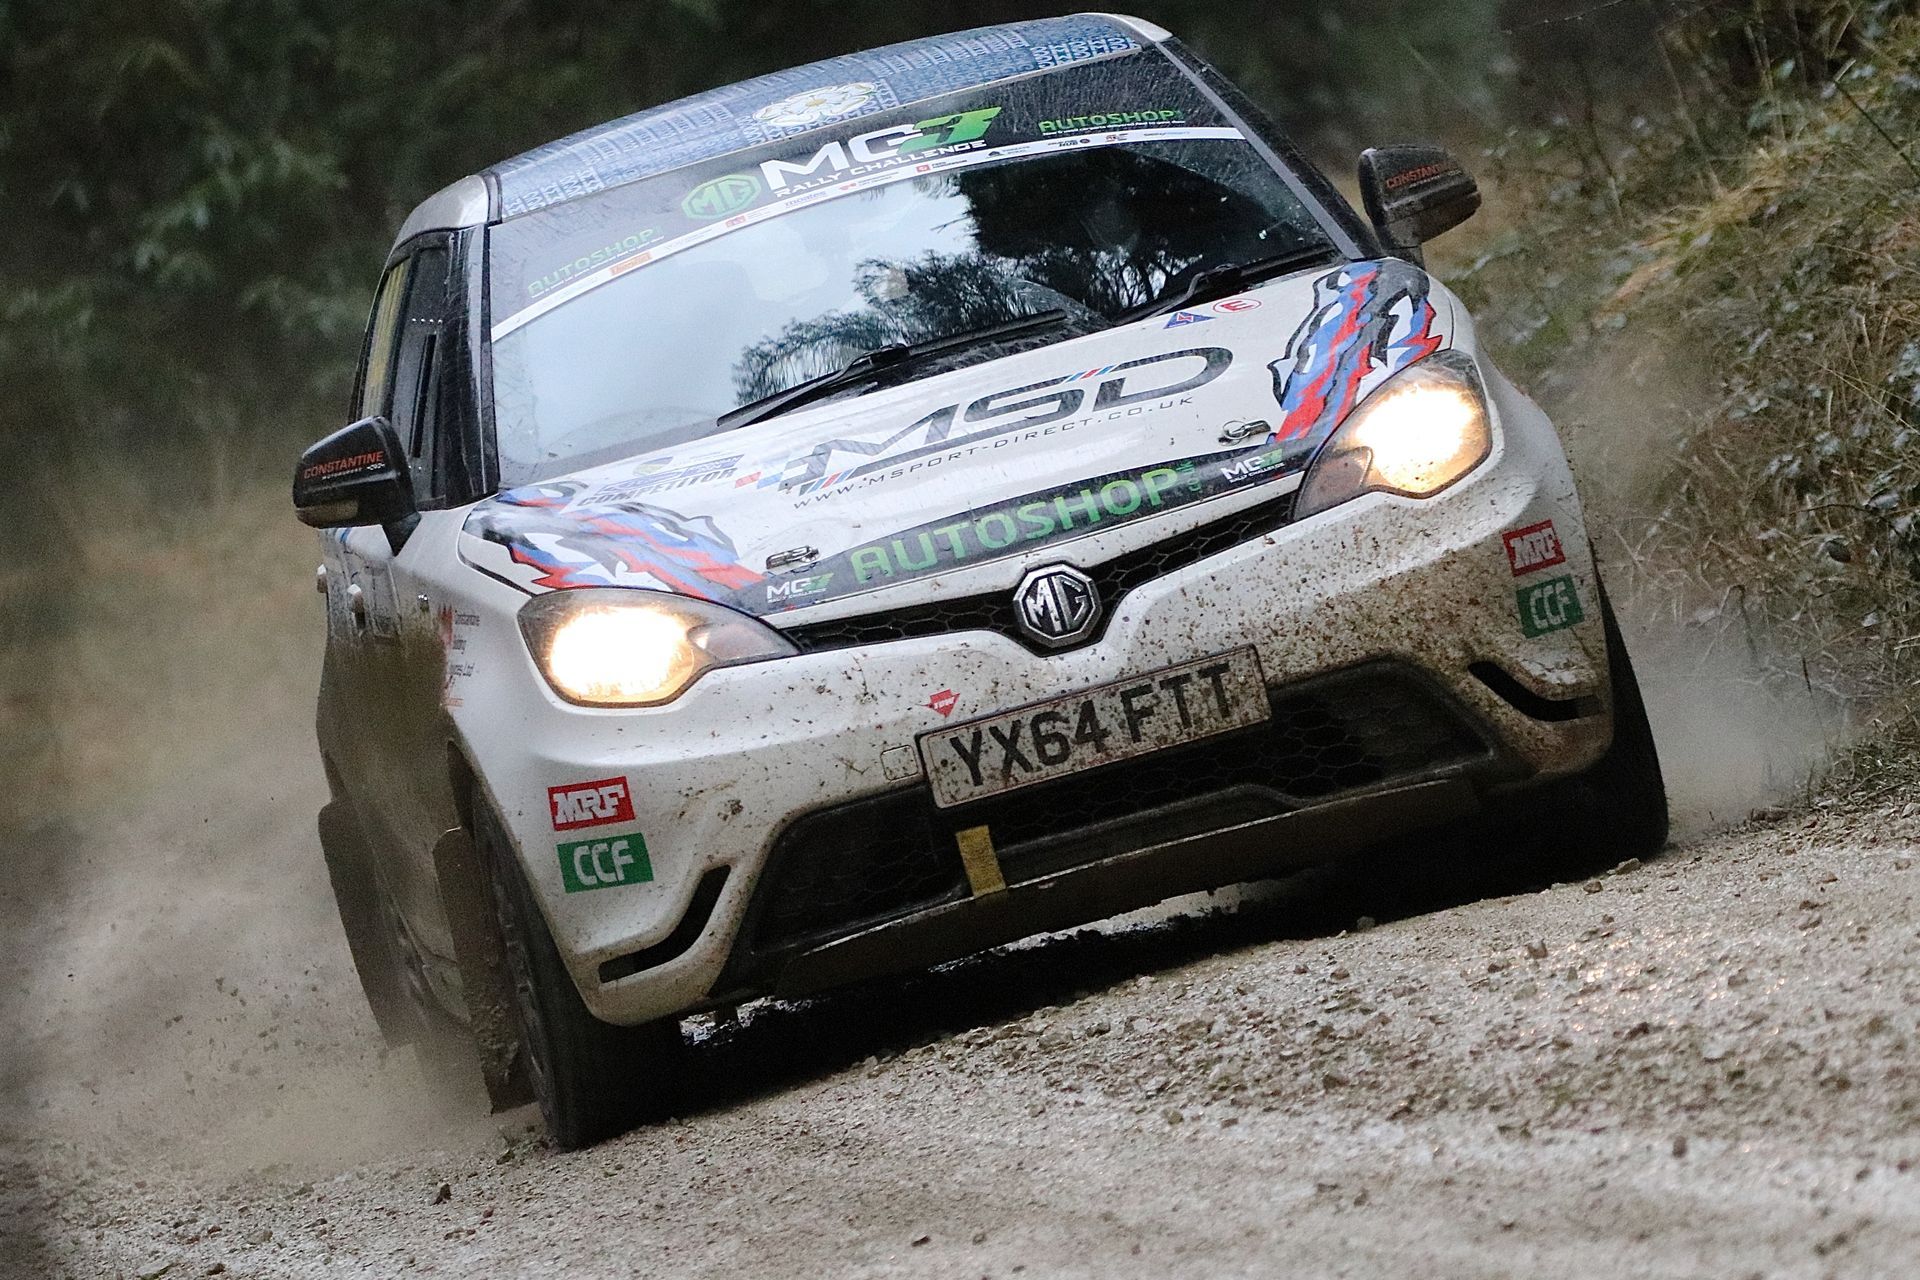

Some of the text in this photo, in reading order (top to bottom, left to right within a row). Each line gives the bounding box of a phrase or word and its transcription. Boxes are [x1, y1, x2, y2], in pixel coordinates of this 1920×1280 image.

[1038, 110, 1175, 132] AUTOSHOP
[775, 171, 842, 198] RALLY
[850, 139, 987, 175] CHALLENGE
[690, 176, 755, 216] MG
[528, 229, 654, 295] AUTOSHOP
[785, 346, 1234, 496] MSD
[304, 450, 386, 479] CONSTANTINE
[850, 468, 1178, 584] AUTOSHOP
[1509, 527, 1558, 570] MRF
[1024, 572, 1090, 633] MG
[1530, 581, 1571, 630] CCF
[950, 663, 1231, 788] YX64 FTT
[553, 783, 626, 825] MRF
[573, 840, 634, 886] CCF
